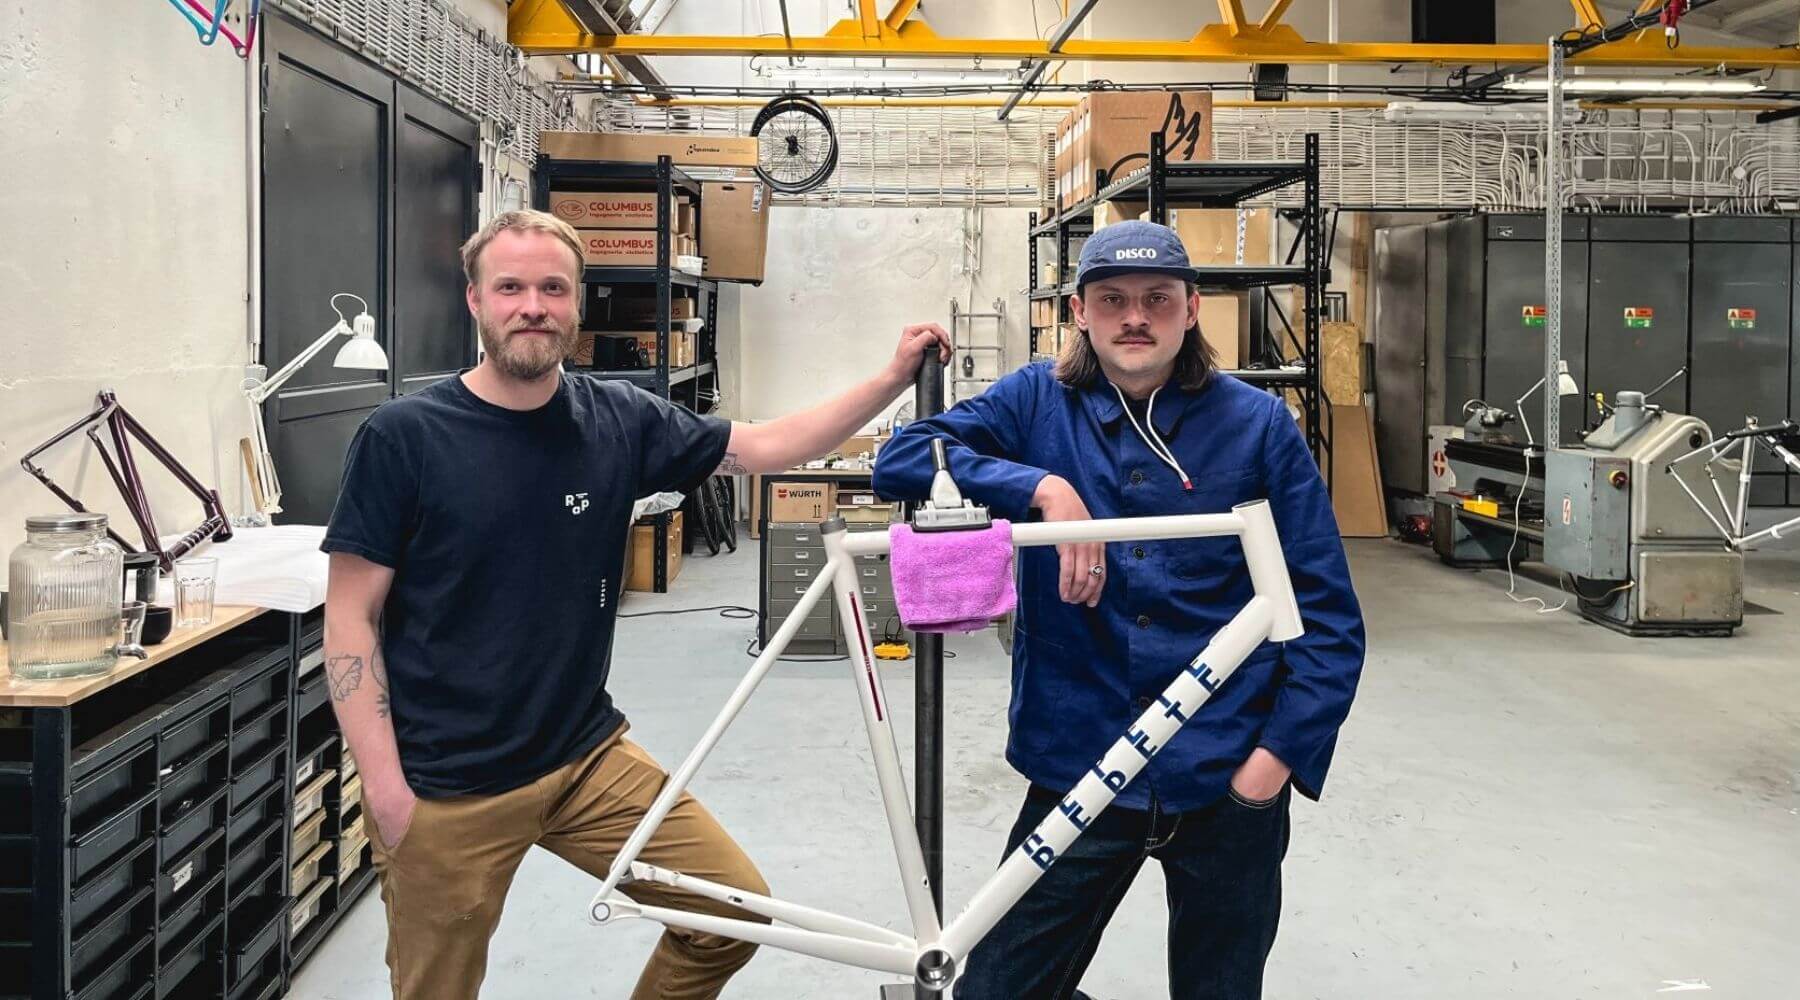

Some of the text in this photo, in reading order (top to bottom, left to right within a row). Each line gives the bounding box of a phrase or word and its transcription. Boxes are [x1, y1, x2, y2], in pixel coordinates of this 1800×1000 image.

[589, 202, 653, 212] COLUMBUS
[589, 239, 654, 249] COLUMBUS
[1115, 248, 1157, 260] DISCO
